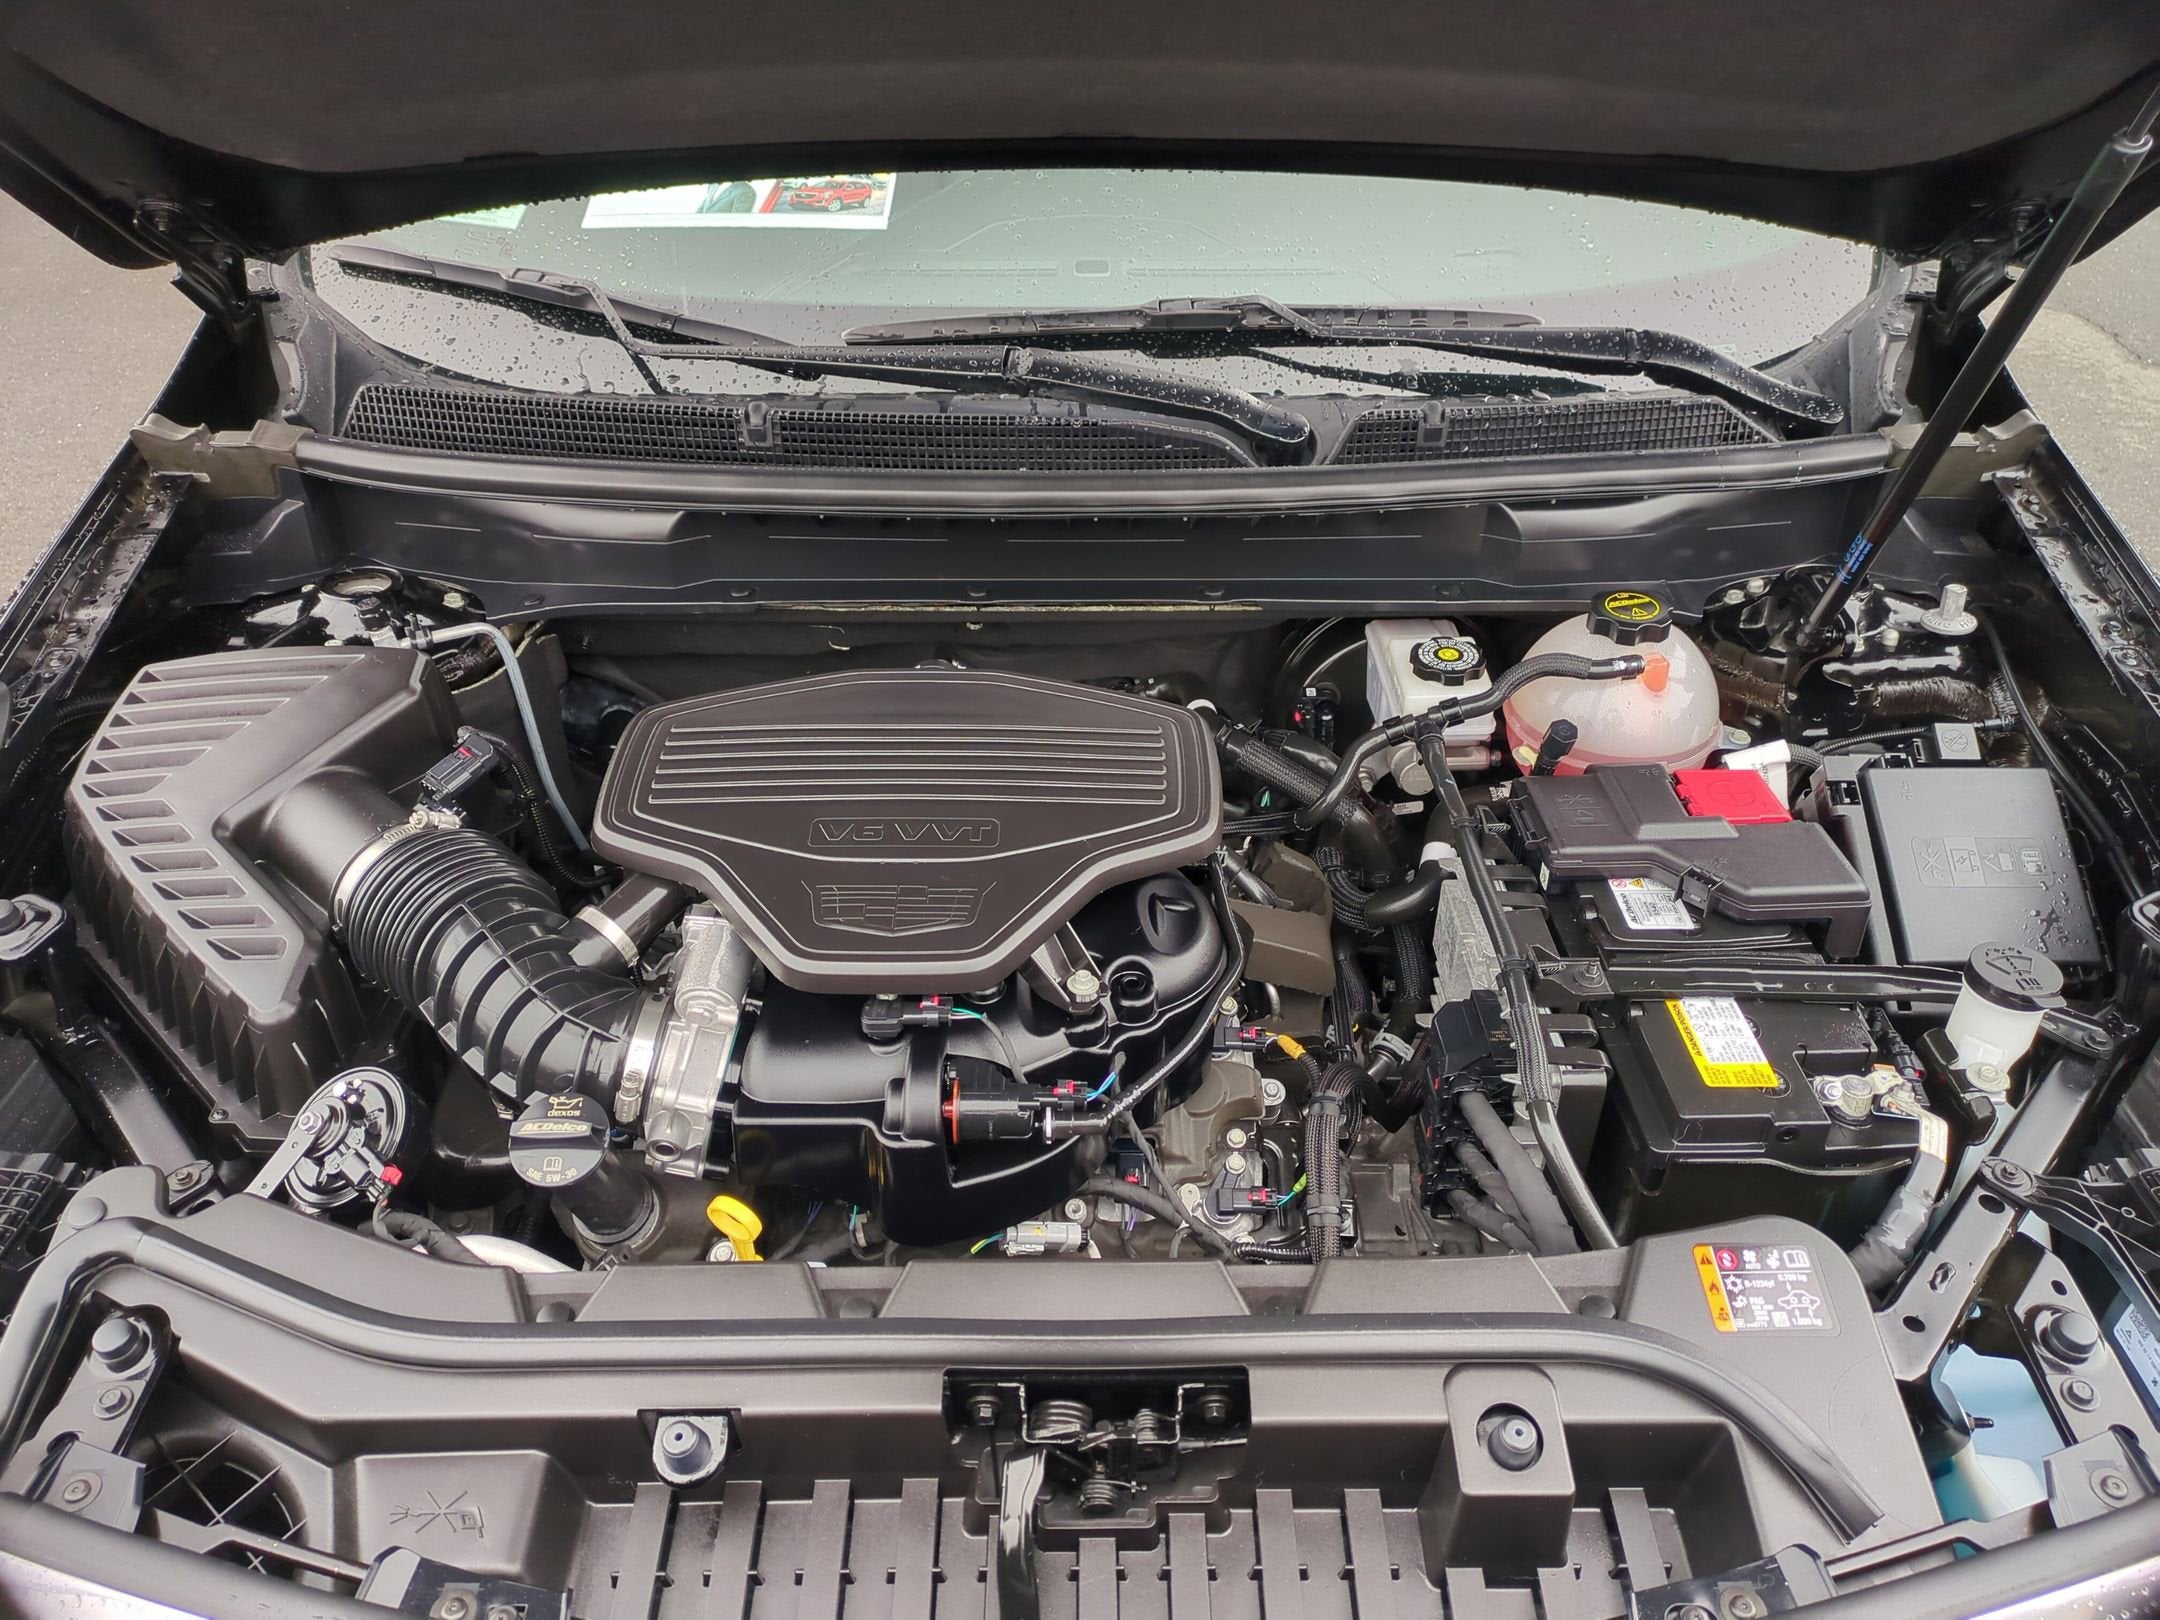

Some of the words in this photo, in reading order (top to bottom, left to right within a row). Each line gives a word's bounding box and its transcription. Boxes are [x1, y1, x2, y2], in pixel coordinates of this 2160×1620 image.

[818, 823, 885, 841] V6
[894, 823, 992, 842] VVT
[547, 1109, 581, 1117] dexos
[520, 1122, 588, 1132] ACDelco
[526, 1167, 543, 1181] SAE
[546, 1167, 578, 1183] 5W-30
